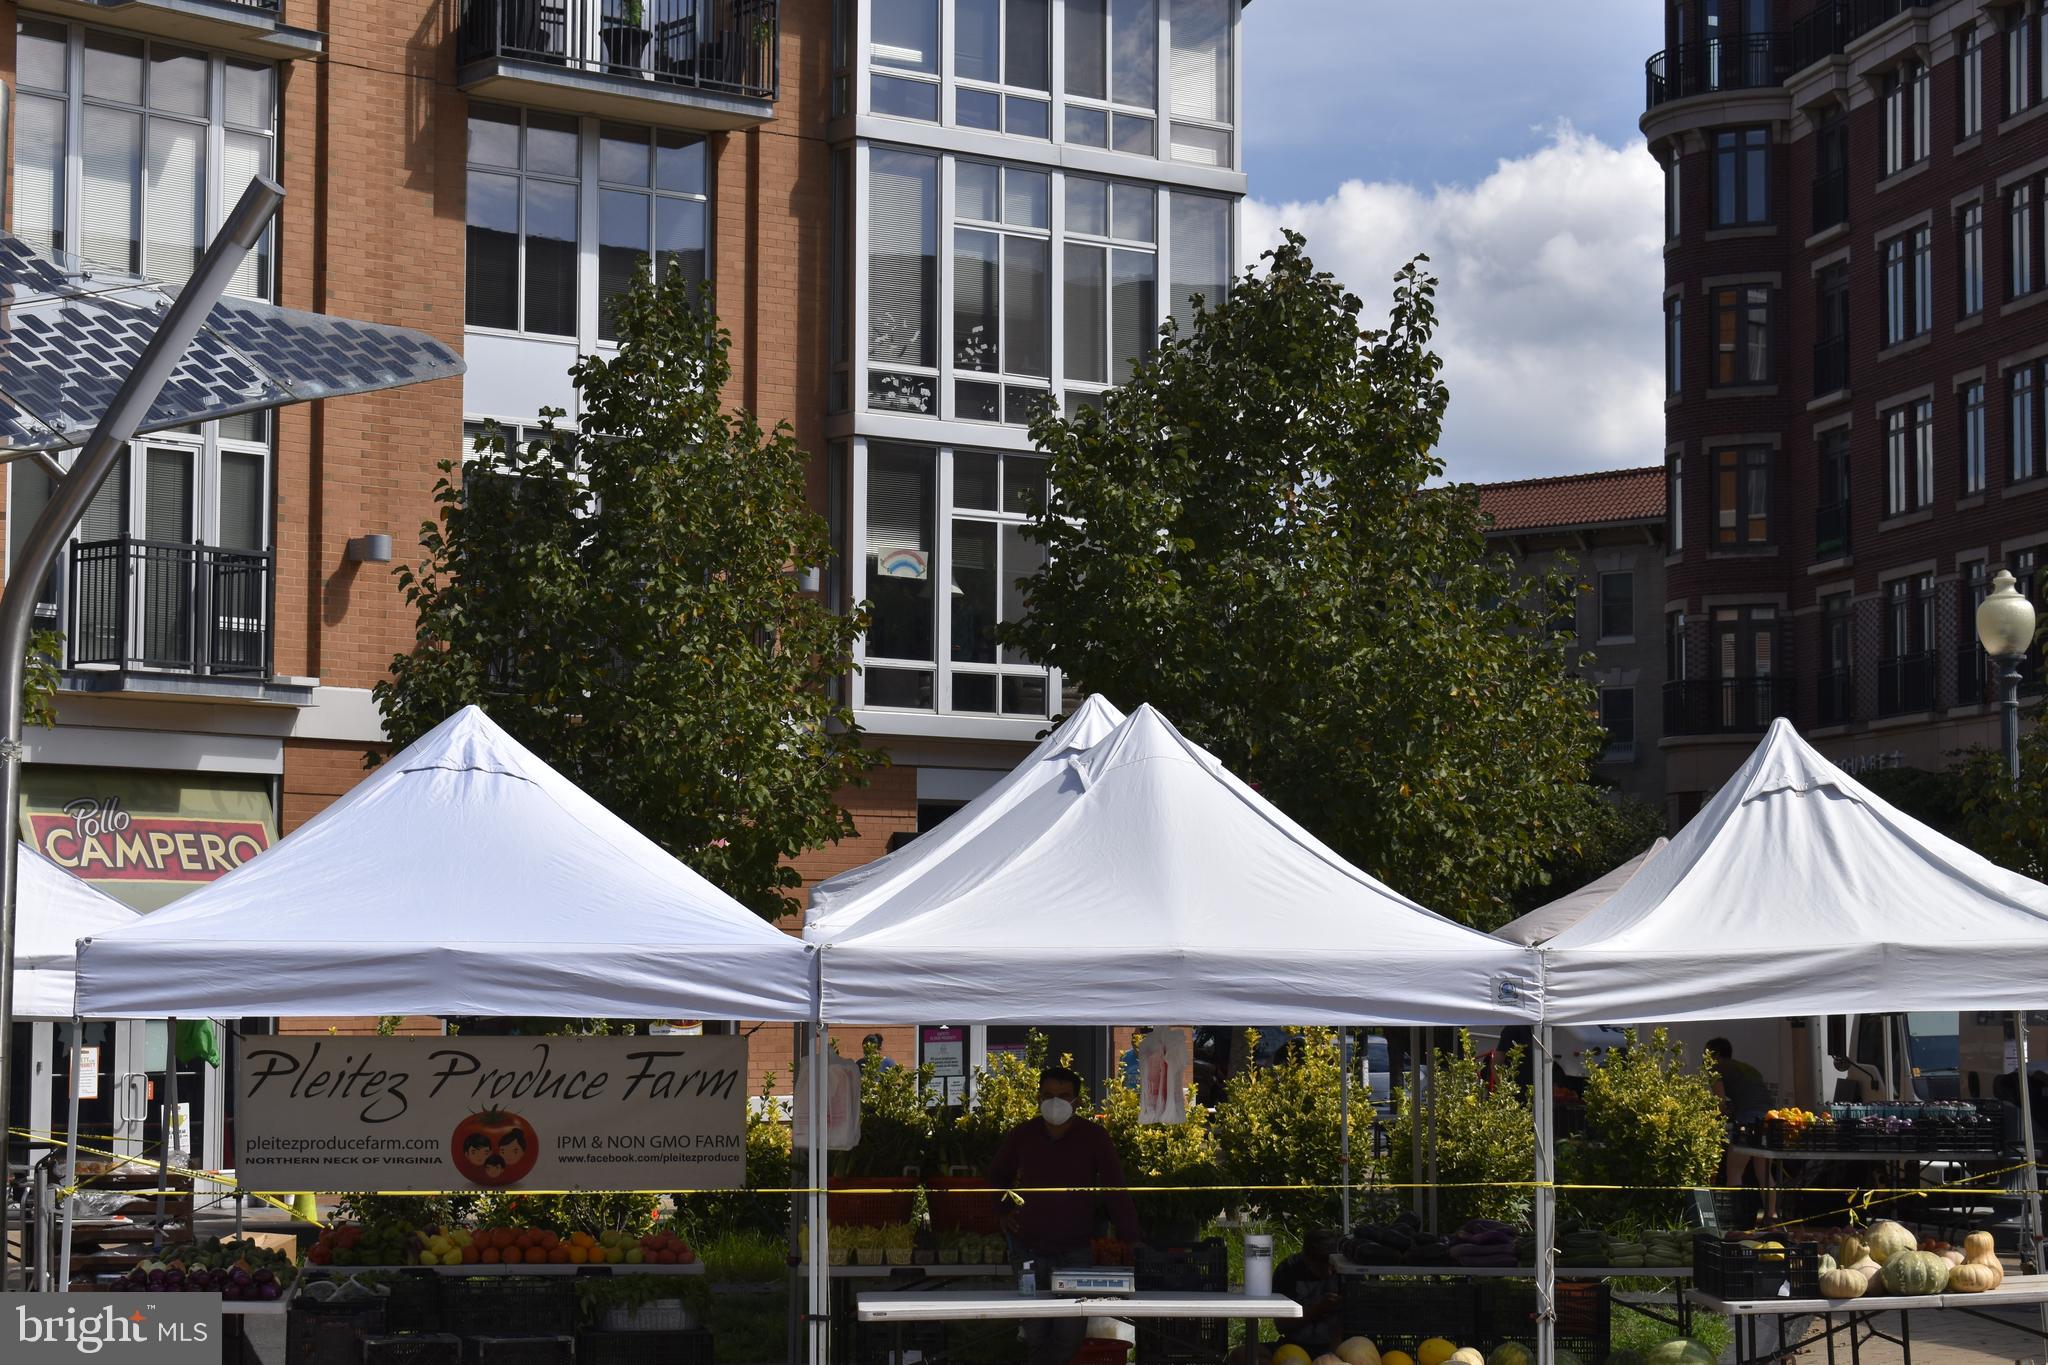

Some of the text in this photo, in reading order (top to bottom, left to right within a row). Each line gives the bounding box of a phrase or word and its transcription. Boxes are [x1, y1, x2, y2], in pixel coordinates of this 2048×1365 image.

[63, 797, 130, 838] Pollo
[45, 828, 263, 872] CAMPERO
[247, 1042, 738, 1123] Pleitez Produce Farm
[246, 1135, 440, 1153] pleitezproducefarm.com
[557, 1134, 741, 1149] IPM & NON GMO FARM
[245, 1156, 443, 1165] NORTHERN NECK OF VIRGINIA
[557, 1152, 741, 1165] www.facebook.com/pleitezproduce
